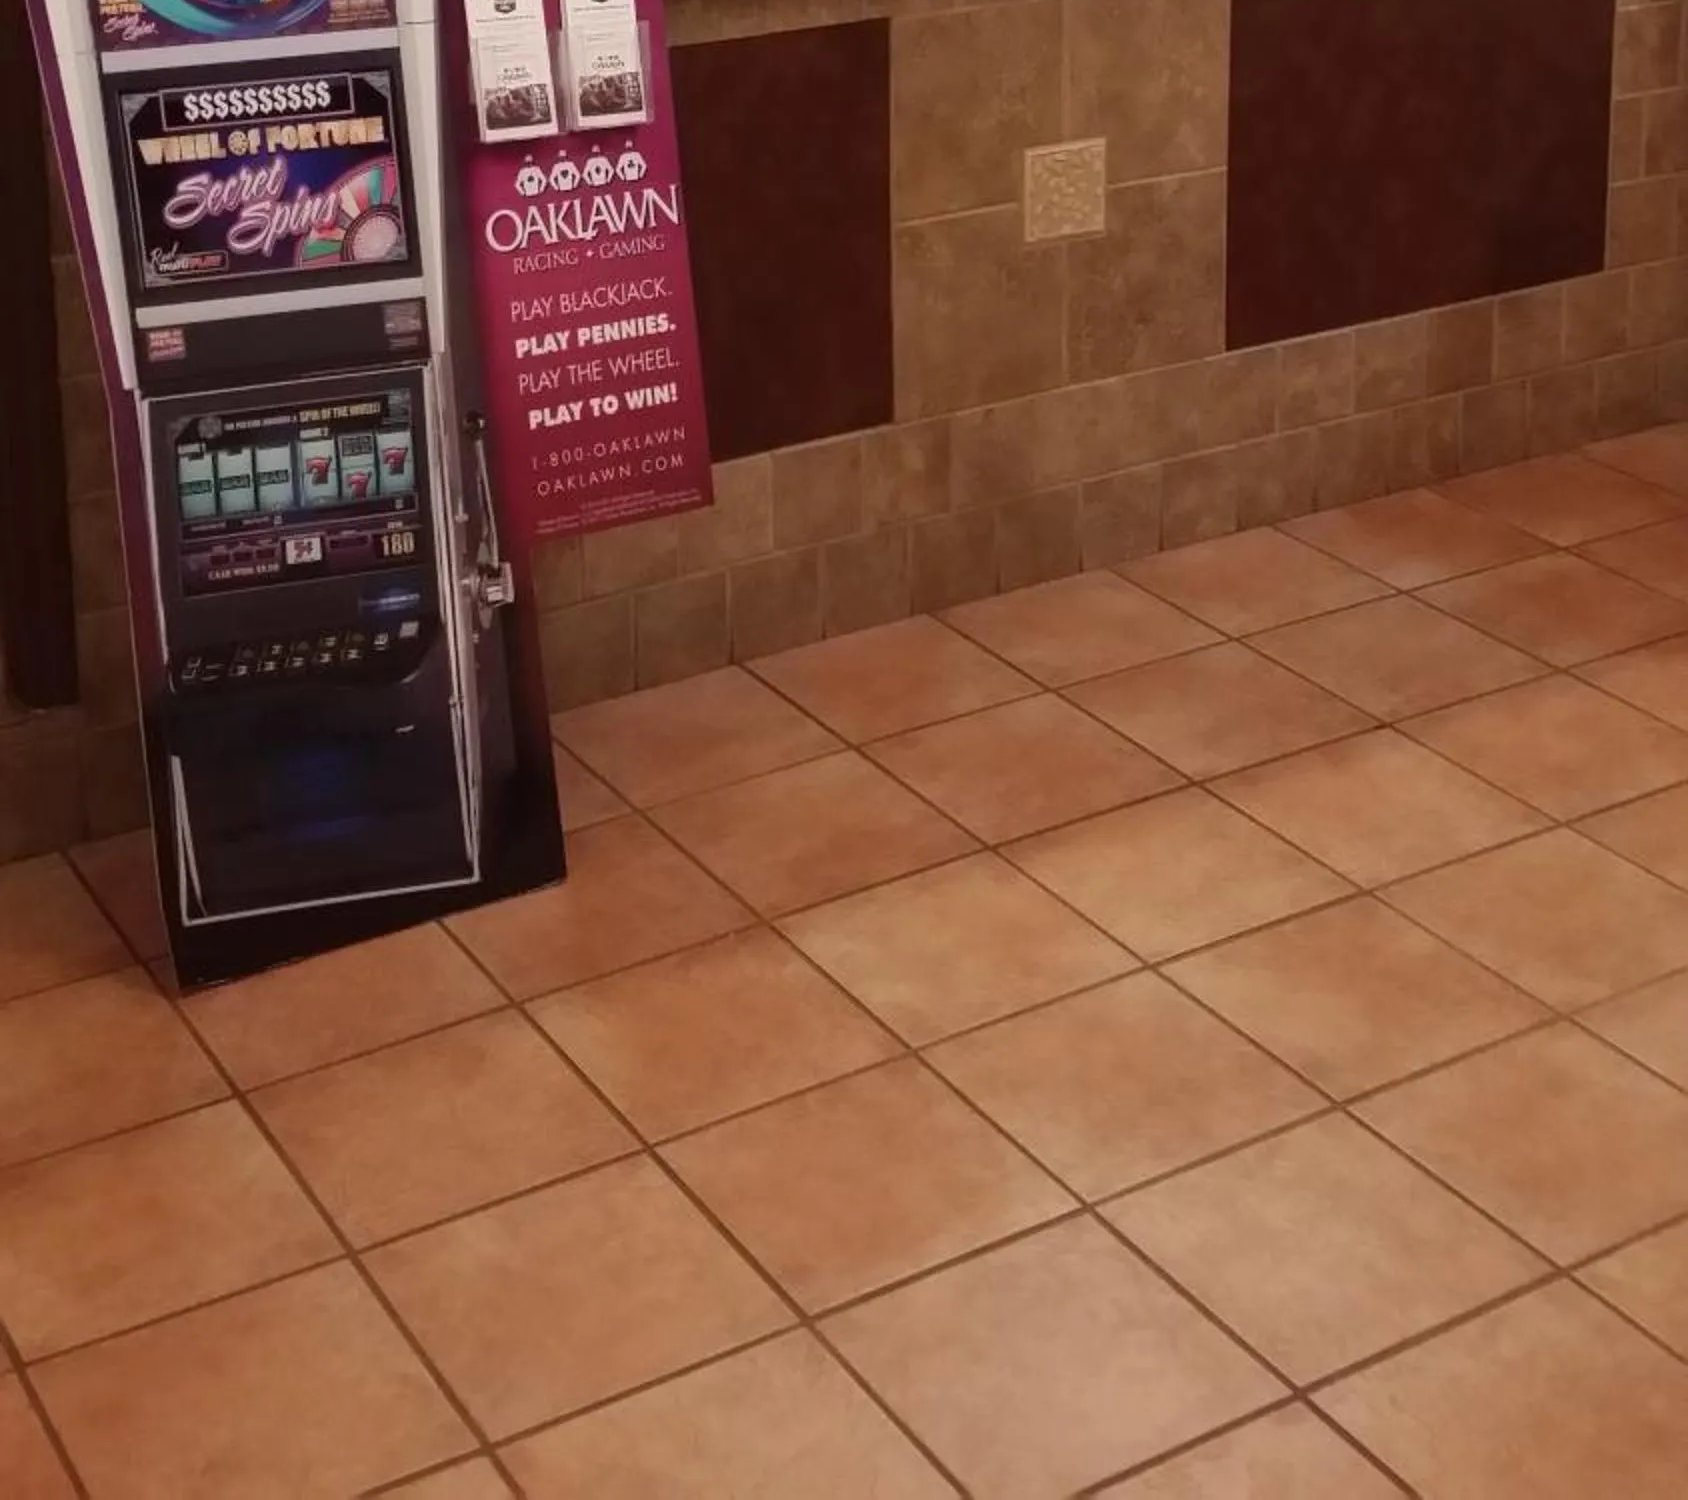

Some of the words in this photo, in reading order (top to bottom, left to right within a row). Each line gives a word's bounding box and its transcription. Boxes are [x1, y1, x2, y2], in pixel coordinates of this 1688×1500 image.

[138, 131, 227, 165] WHEEL
[227, 129, 262, 156] OF
[266, 116, 385, 153] FORTUNE
[164, 155, 287, 229] Secret
[227, 186, 338, 257] Spins
[485, 183, 681, 253] OAKLAWN
[513, 247, 579, 275] RACING
[599, 233, 666, 260] GAMING
[510, 295, 554, 323] PLAY
[559, 276, 674, 315] BLACKJACK.
[514, 329, 570, 360] PLAY
[577, 312, 677, 348] PENNIES.
[518, 368, 561, 396] PLAY
[567, 360, 604, 387] THE
[607, 346, 680, 377] WHEEL.
[527, 400, 584, 431] PLAY
[589, 391, 620, 418] TO
[624, 381, 679, 410] WIN!
[531, 426, 687, 471] 1-800-OAKLAWN
[536, 454, 686, 498] OAKLAWN.COM
